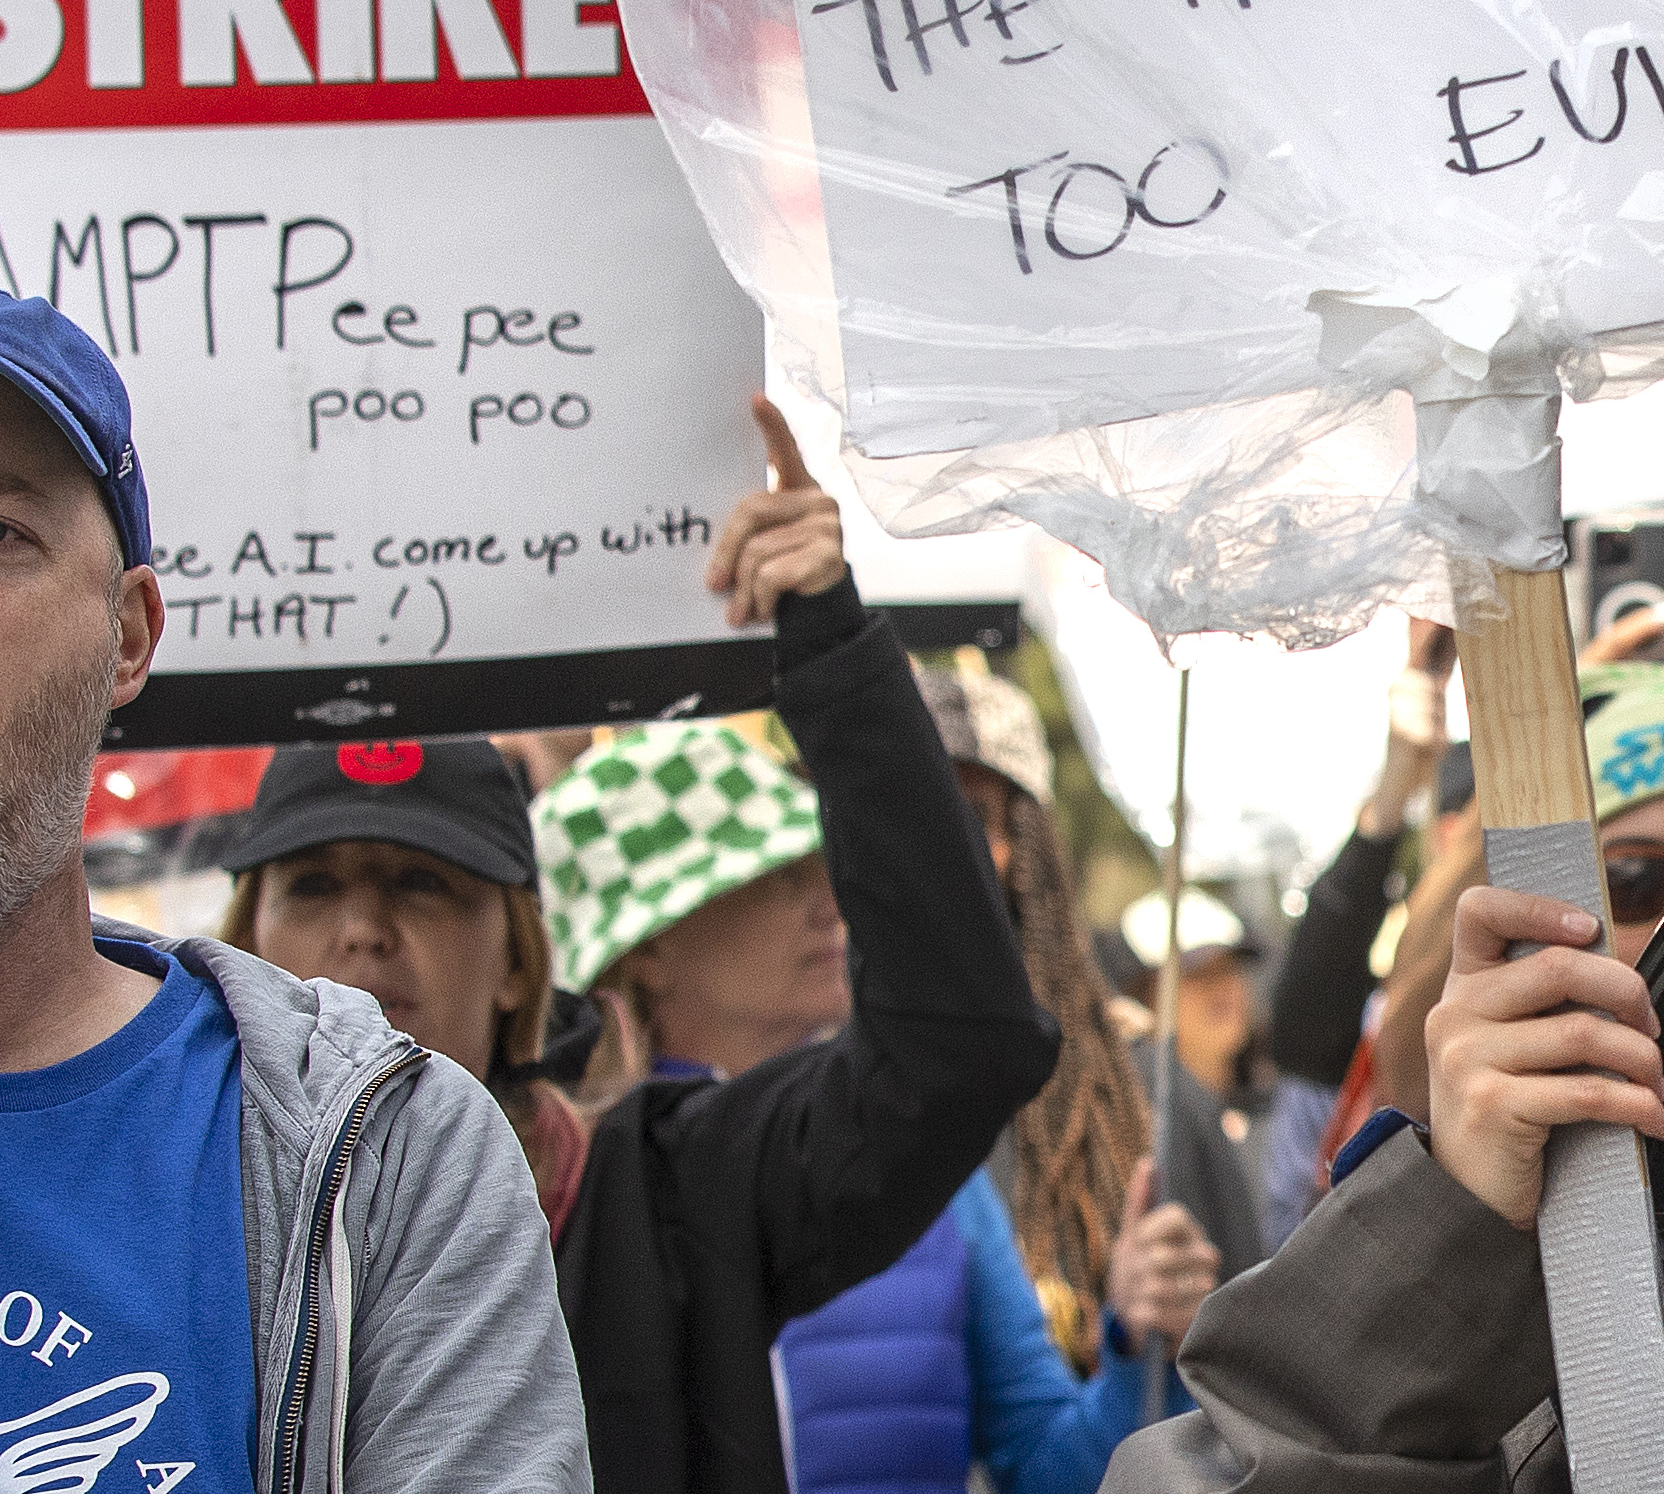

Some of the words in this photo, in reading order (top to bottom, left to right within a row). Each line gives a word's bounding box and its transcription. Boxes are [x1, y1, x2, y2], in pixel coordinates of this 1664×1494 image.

[946, 137, 1230, 275] TOO
[458, 305, 594, 375] pee
[309, 389, 425, 451] poo
[469, 392, 592, 444] poo
[150, 543, 212, 579] ee
[232, 529, 354, 577] A.I.
[373, 531, 506, 570] come
[523, 531, 580, 574] up
[601, 505, 711, 555] with
